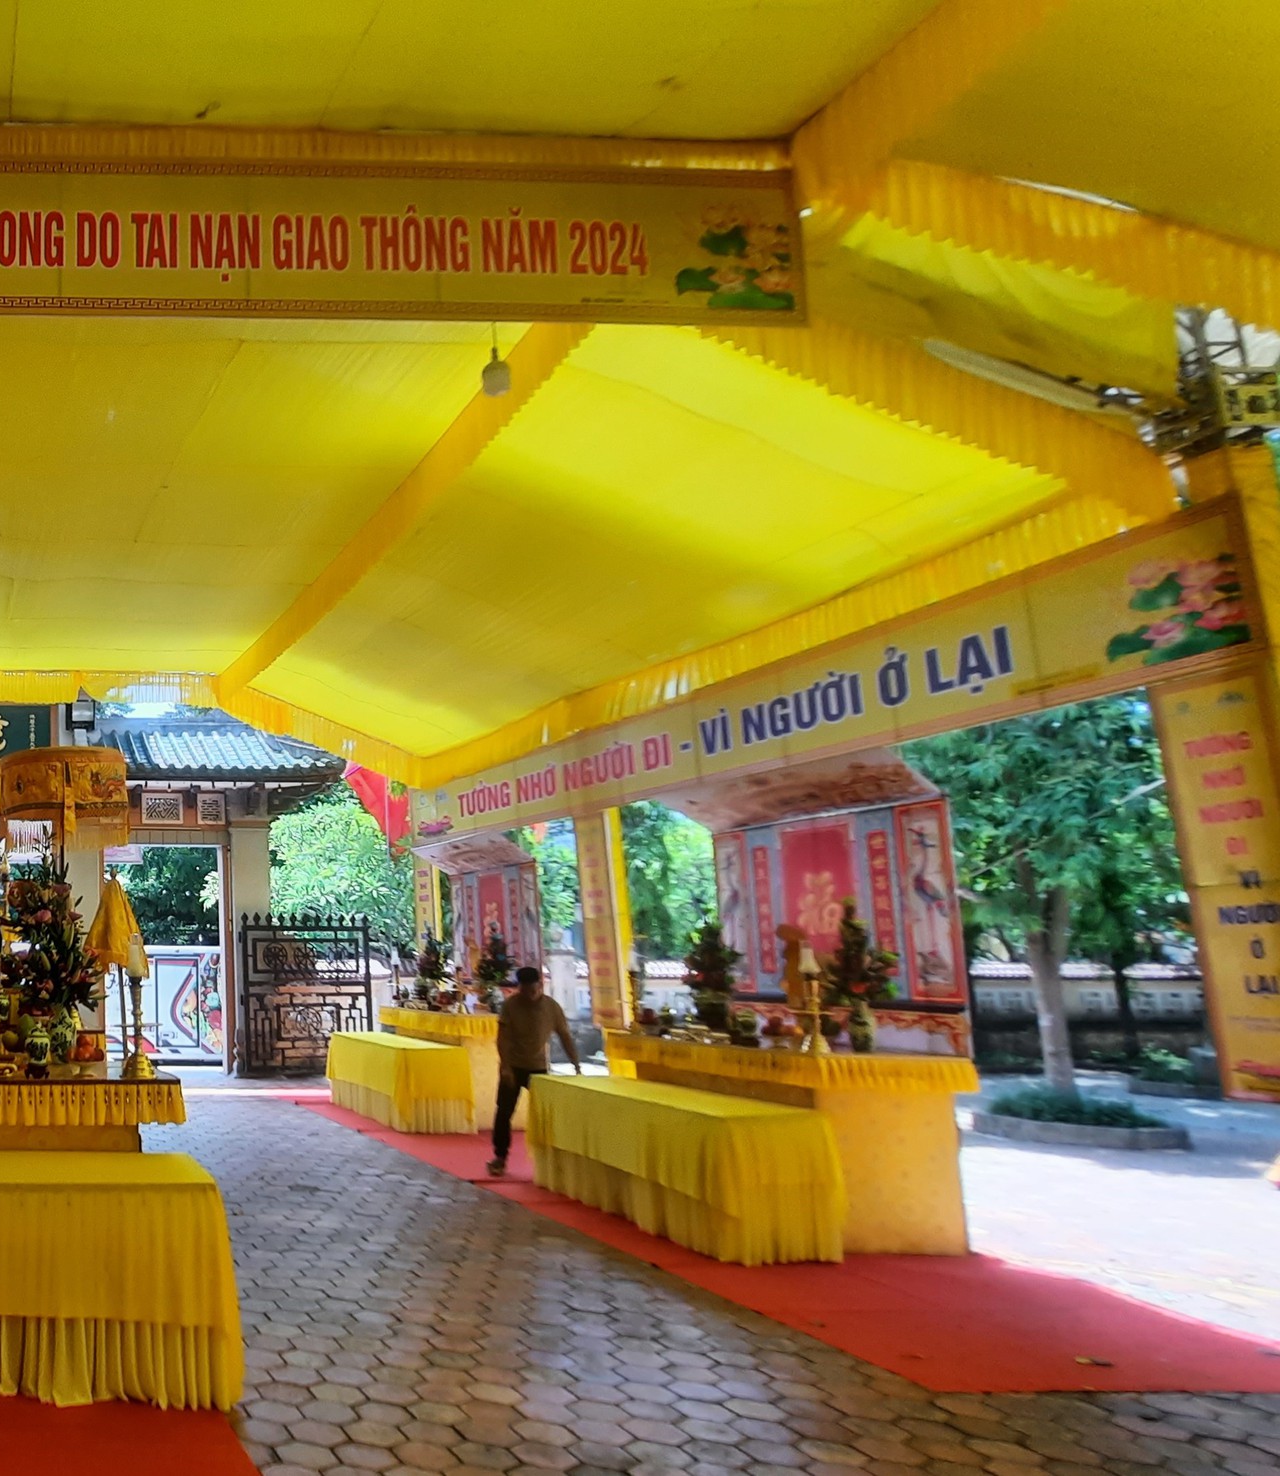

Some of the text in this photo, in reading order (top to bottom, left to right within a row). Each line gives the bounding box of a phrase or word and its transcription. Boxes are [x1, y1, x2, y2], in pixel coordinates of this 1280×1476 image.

[76, 211, 121, 268] DO
[131, 211, 178, 268] TAI
[189, 213, 261, 282] NẠN
[272, 214, 350, 271] GIAO
[359, 204, 471, 273] THÔNG
[481, 207, 558, 274] NĂM
[568, 220, 648, 276] 2024
[457, 779, 512, 818] TƯỞNG
[515, 762, 557, 804] NHỚ
[562, 741, 637, 793] NGƯỜI
[642, 733, 672, 772] ĐI
[698, 708, 733, 757] VÌ
[740, 670, 864, 745] NGƯỜI
[876, 646, 910, 708] Ở
[924, 626, 1015, 695] LẠI
